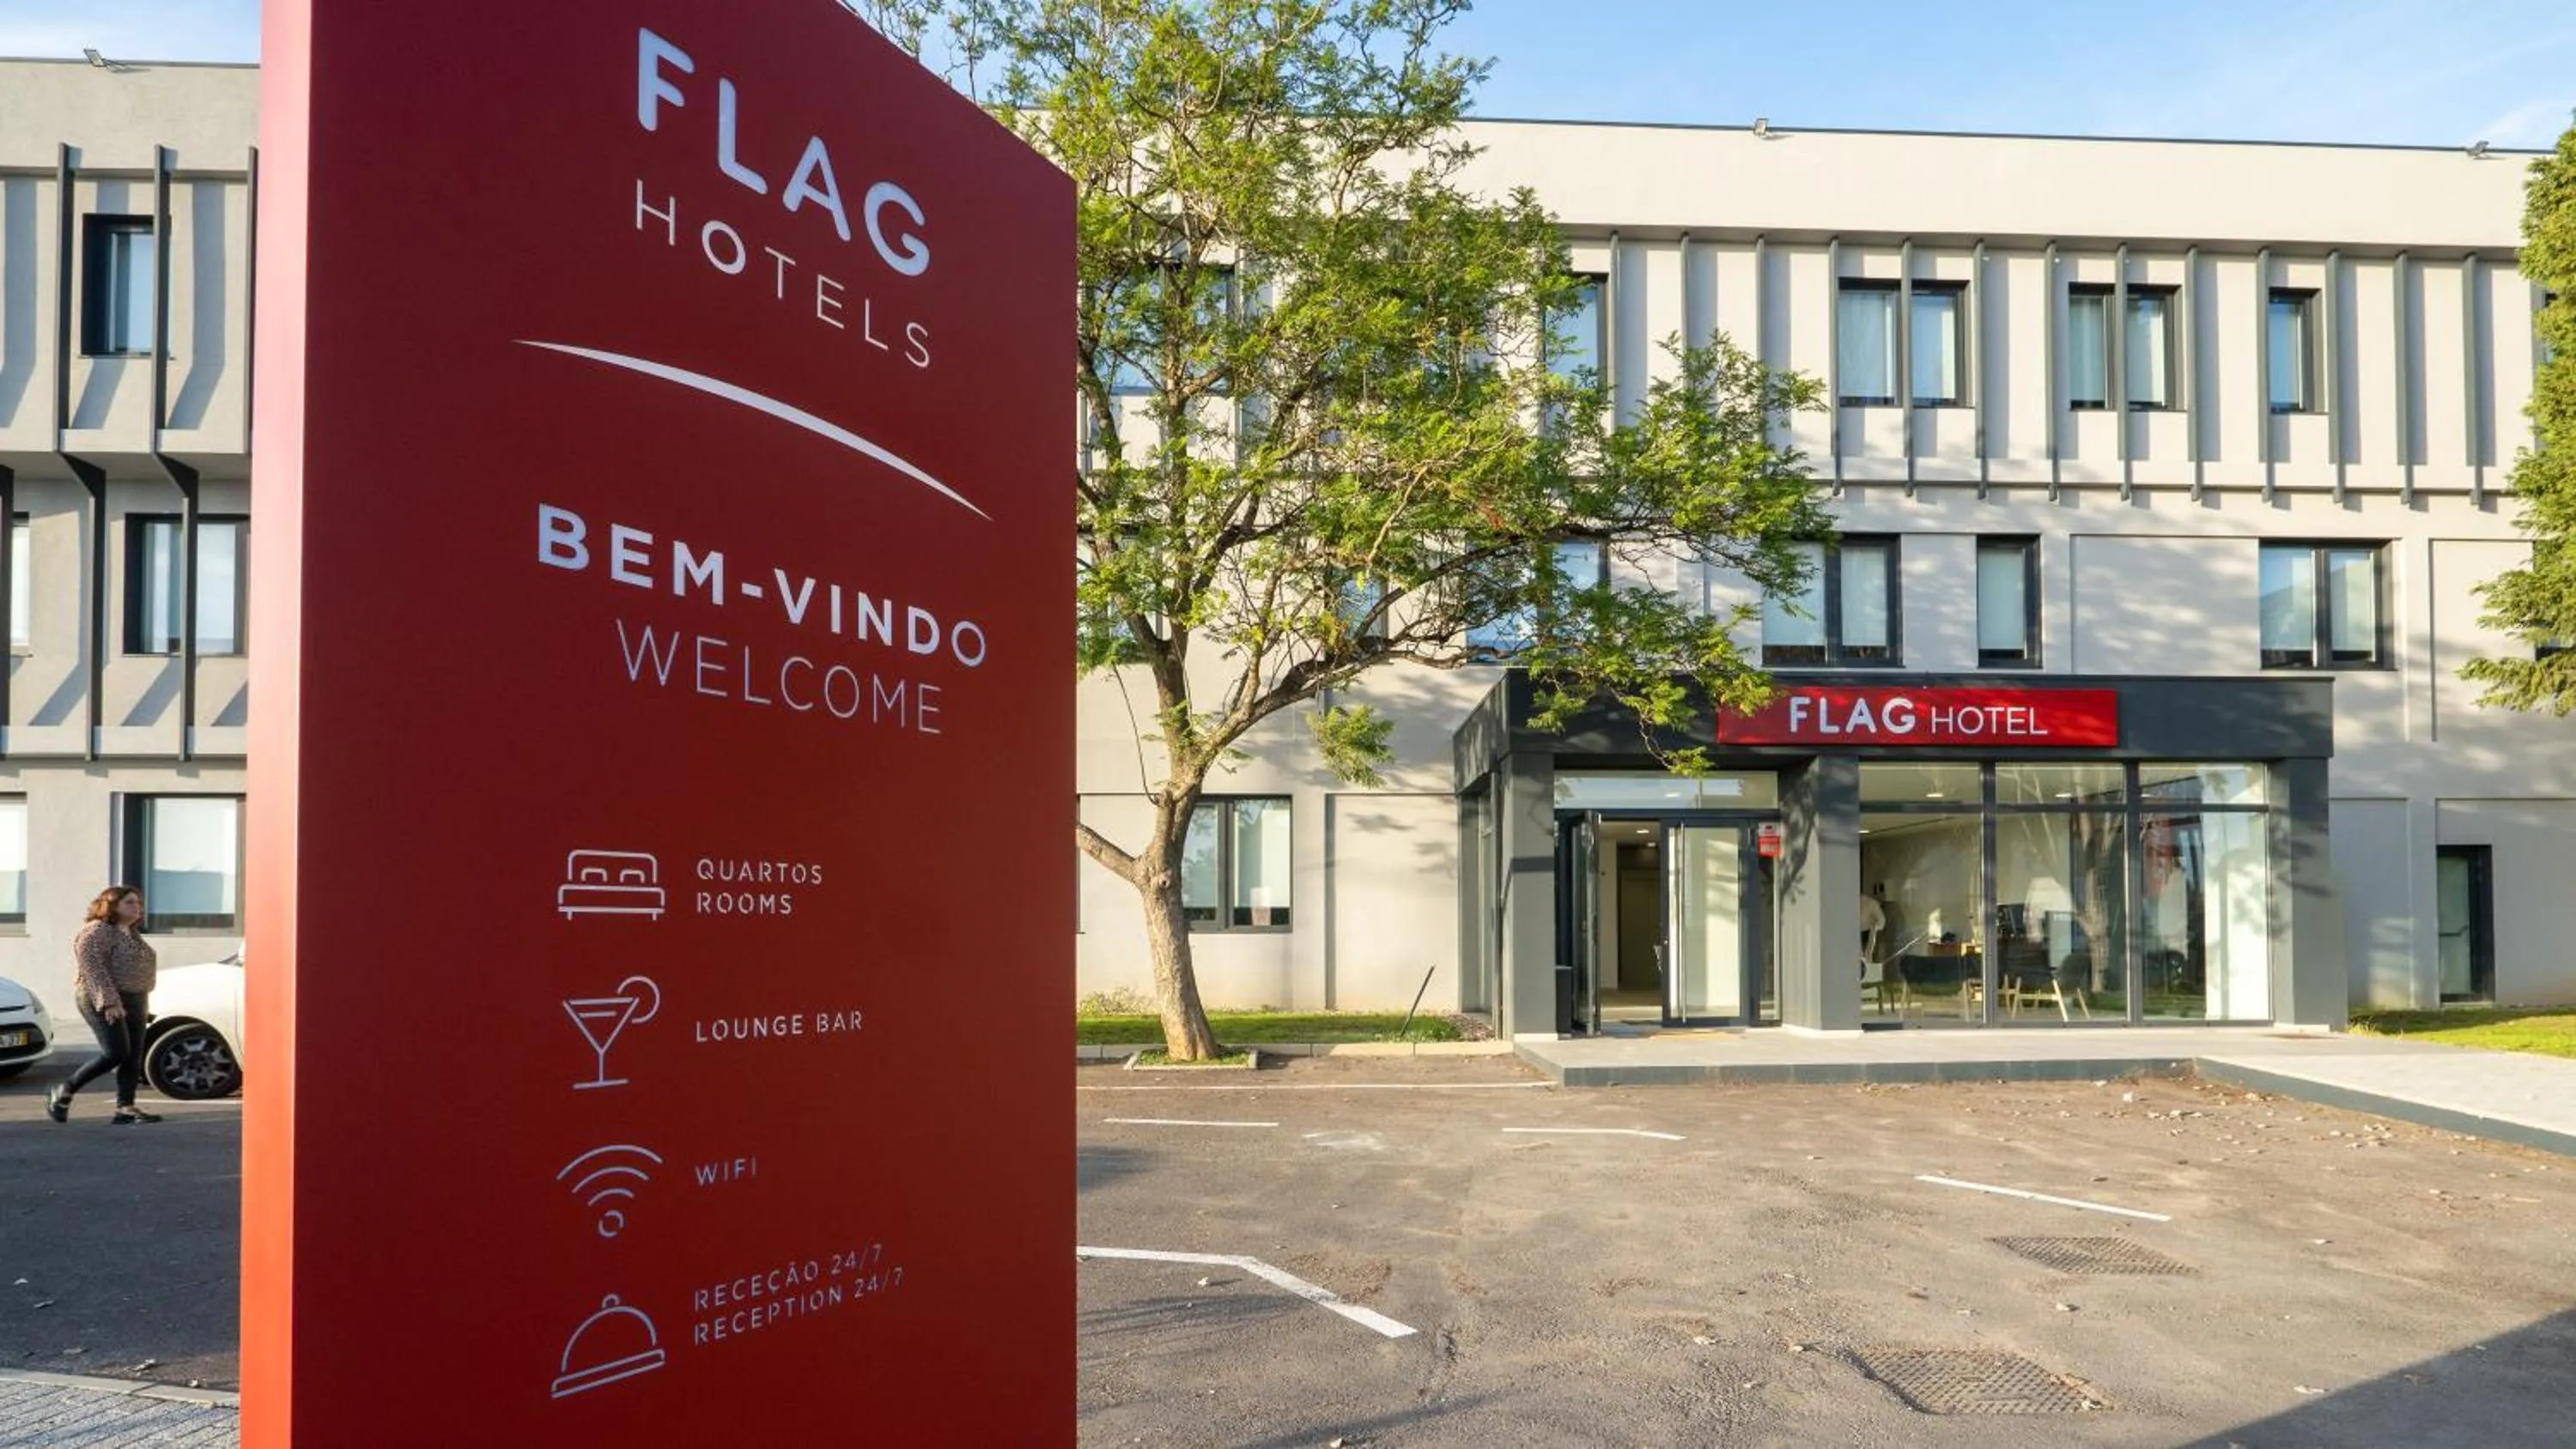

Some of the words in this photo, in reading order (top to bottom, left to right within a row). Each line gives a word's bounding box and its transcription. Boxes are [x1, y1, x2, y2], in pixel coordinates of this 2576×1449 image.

[637, 27, 931, 277] FLAG
[635, 179, 931, 368] HOTELS
[538, 503, 987, 668] BEM-VINDO
[616, 618, 942, 734] WELCOME
[1789, 696, 1916, 733] FLAG
[1931, 706, 2048, 734] HOTEL
[696, 858, 823, 884] QUARTOS
[696, 893, 793, 914] ROOMS
[696, 1015, 804, 1042] LOUNGE
[816, 1011, 862, 1033] BAR
[695, 1156, 757, 1185] WIFI
[695, 1260, 818, 1311] RECEÇÃO
[830, 1243, 883, 1276] 24/7
[695, 1286, 841, 1344] RECEPTION
[854, 1266, 903, 1299] 24/7
